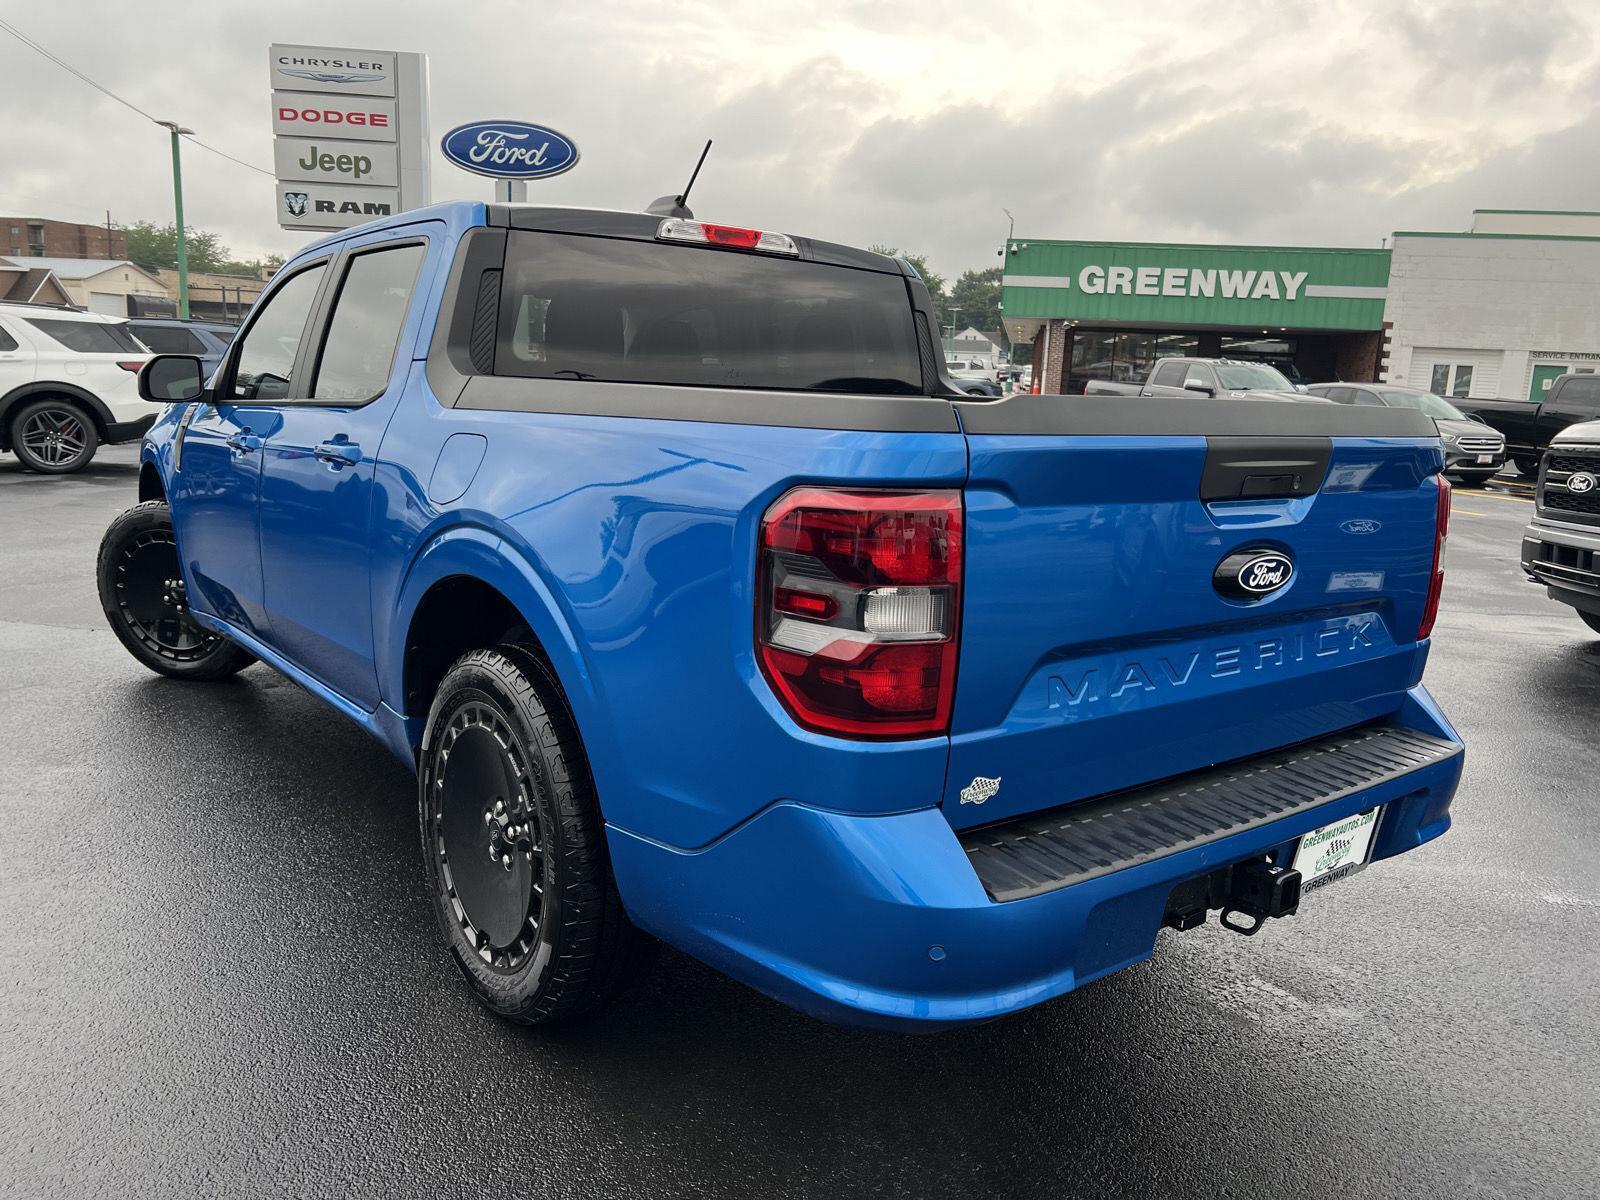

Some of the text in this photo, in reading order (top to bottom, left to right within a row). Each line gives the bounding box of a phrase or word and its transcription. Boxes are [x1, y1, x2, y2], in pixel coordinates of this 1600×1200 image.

[278, 56, 384, 71] CHRYSLER
[279, 108, 389, 127] DODGE
[299, 146, 372, 178] Jeep
[469, 130, 550, 167] Ford
[315, 200, 391, 216] RAM
[1078, 265, 1308, 300] GREENWAY
[1533, 351, 1567, 360] SERVICE
[1249, 562, 1284, 587] Ford
[1048, 622, 1372, 709] MAVERICK
[1303, 811, 1375, 849] GREENWAYAUTOS.COM
